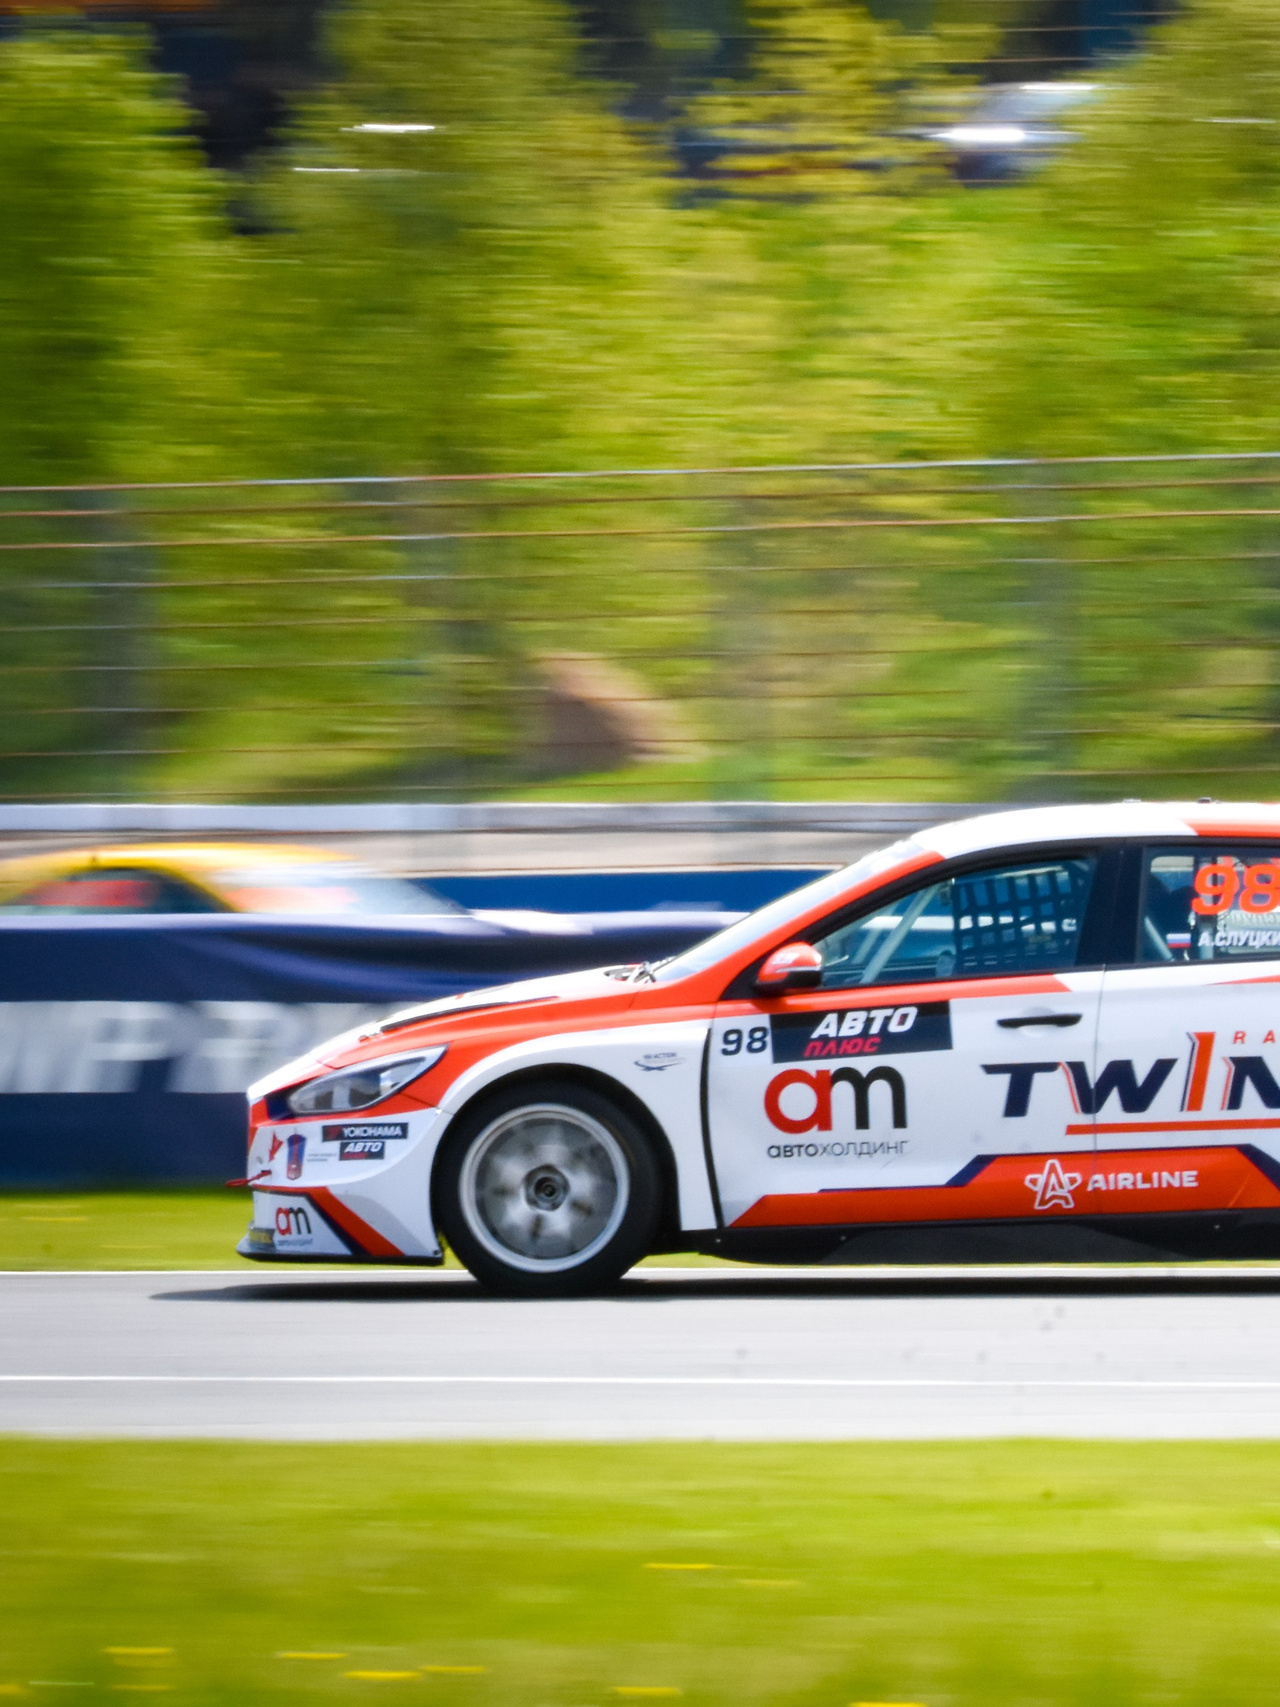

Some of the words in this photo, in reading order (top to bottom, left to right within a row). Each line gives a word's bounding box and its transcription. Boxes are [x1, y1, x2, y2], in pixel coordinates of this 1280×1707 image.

[810, 1006, 918, 1038] АВТО
[721, 1026, 769, 1056] 98
[803, 1036, 882, 1058] ПЛЮС
[342, 1125, 403, 1138] YOKOHAMA
[344, 1142, 383, 1153] АВТО
[767, 1140, 909, 1160] автохолдинг
[1087, 1170, 1199, 1192] AIRLINE
